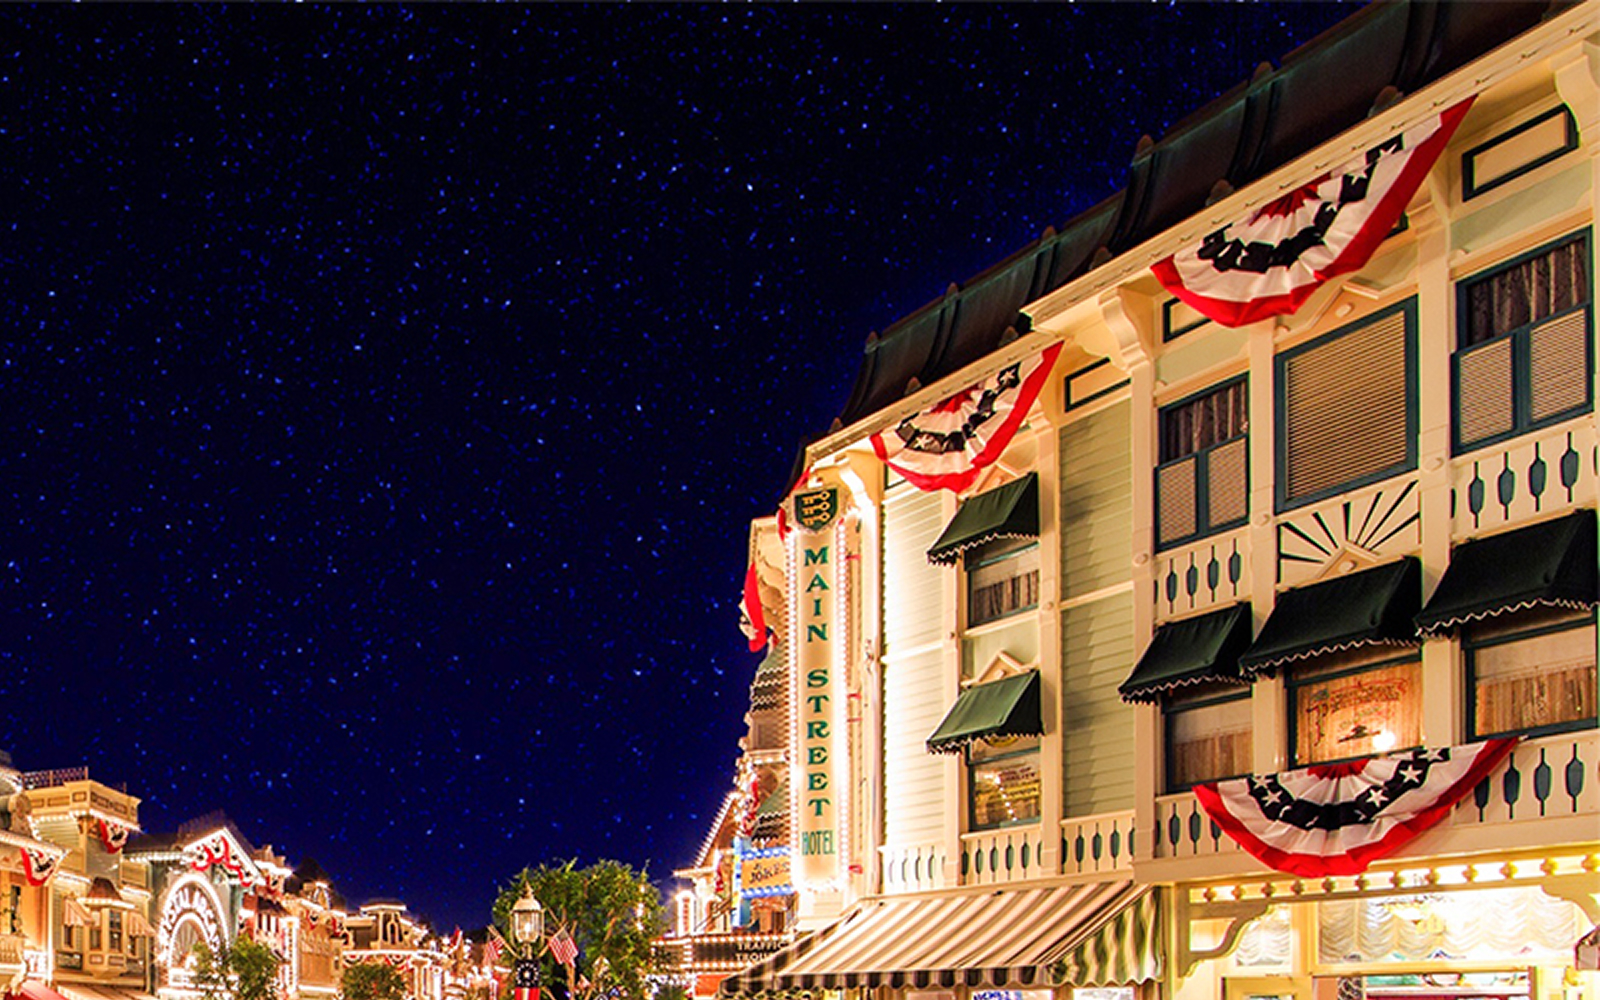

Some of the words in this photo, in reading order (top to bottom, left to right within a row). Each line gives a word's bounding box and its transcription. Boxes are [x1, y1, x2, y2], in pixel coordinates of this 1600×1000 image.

[804, 546, 830, 642] MAIN
[806, 669, 831, 816] STREET
[802, 829, 835, 856] HOTEL
[735, 952, 773, 962] TROU
